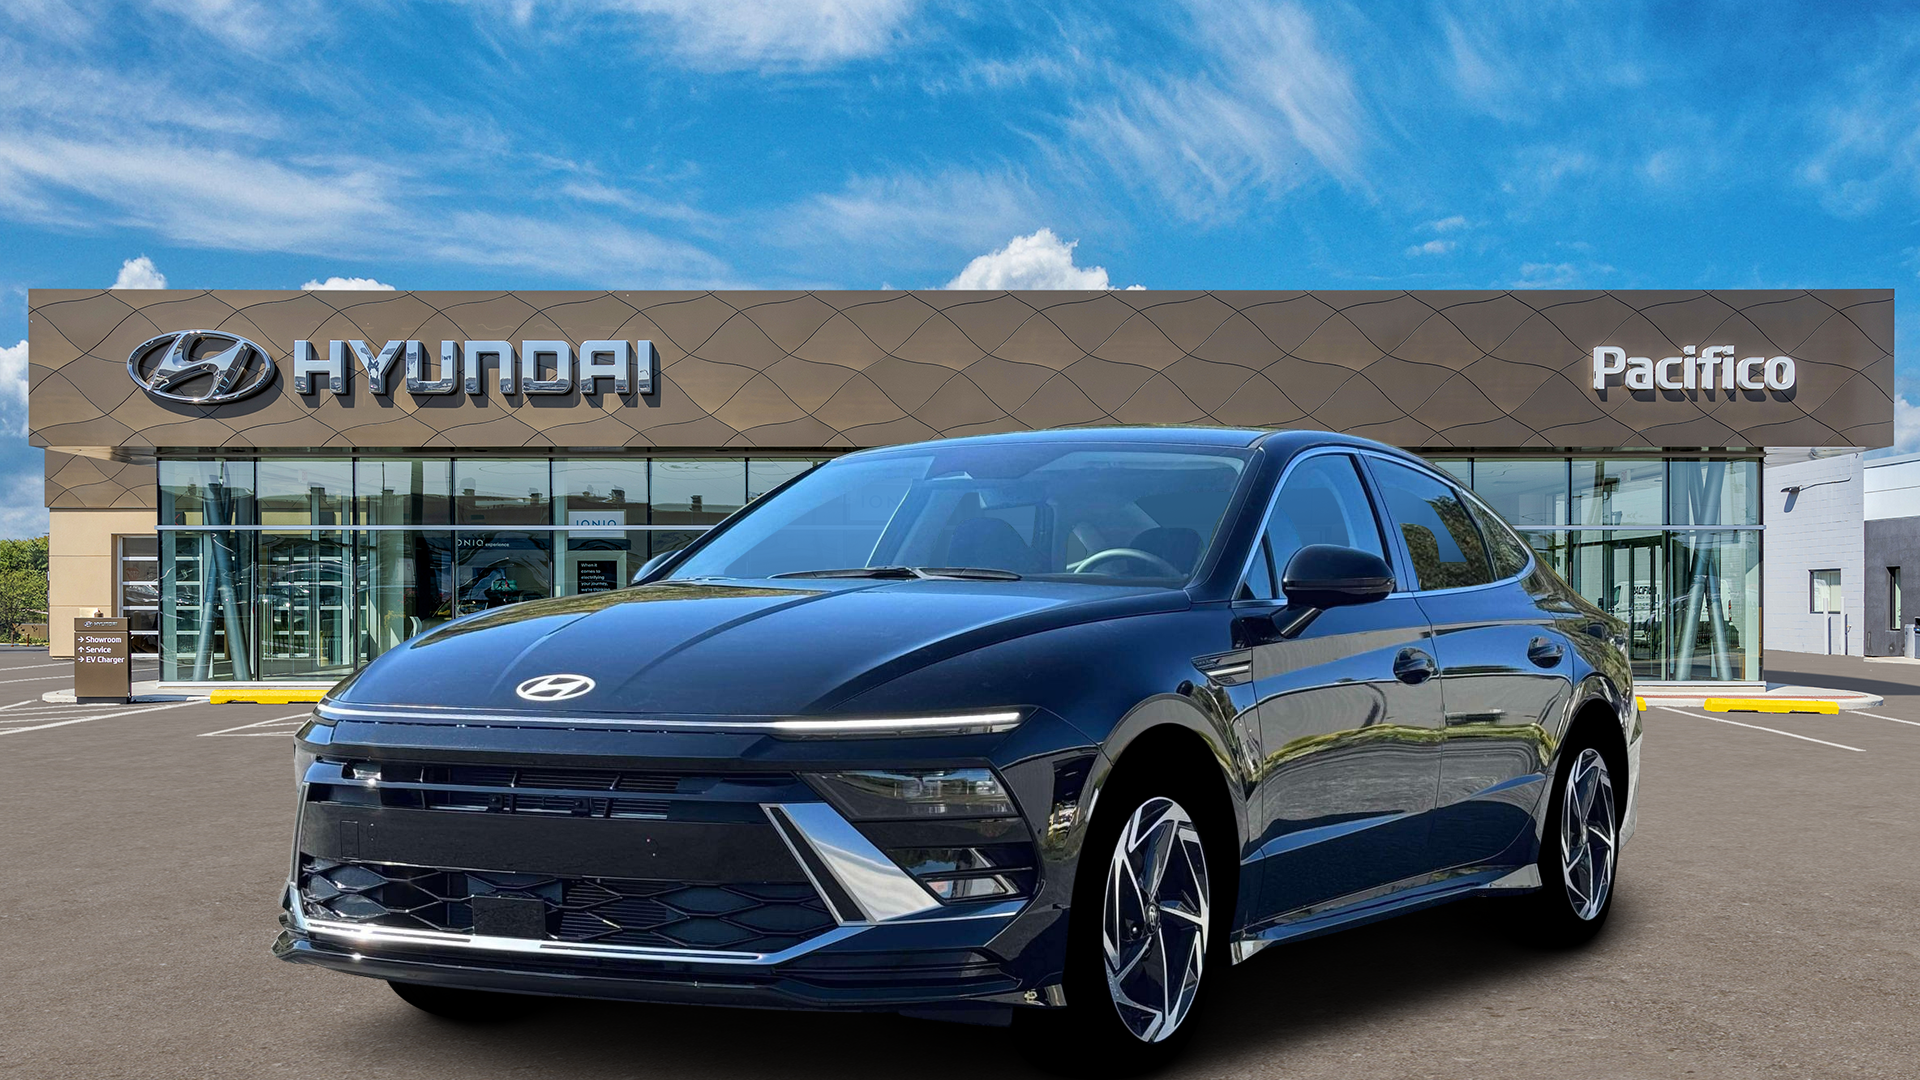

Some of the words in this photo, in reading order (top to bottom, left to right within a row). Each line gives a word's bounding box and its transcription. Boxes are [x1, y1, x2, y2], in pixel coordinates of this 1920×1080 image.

[294, 340, 656, 395] HYUNDAI
[1593, 344, 1796, 391] Pacifico
[458, 539, 484, 547] ONIQ
[85, 635, 122, 643] Showroom
[97, 656, 125, 664] Charger
